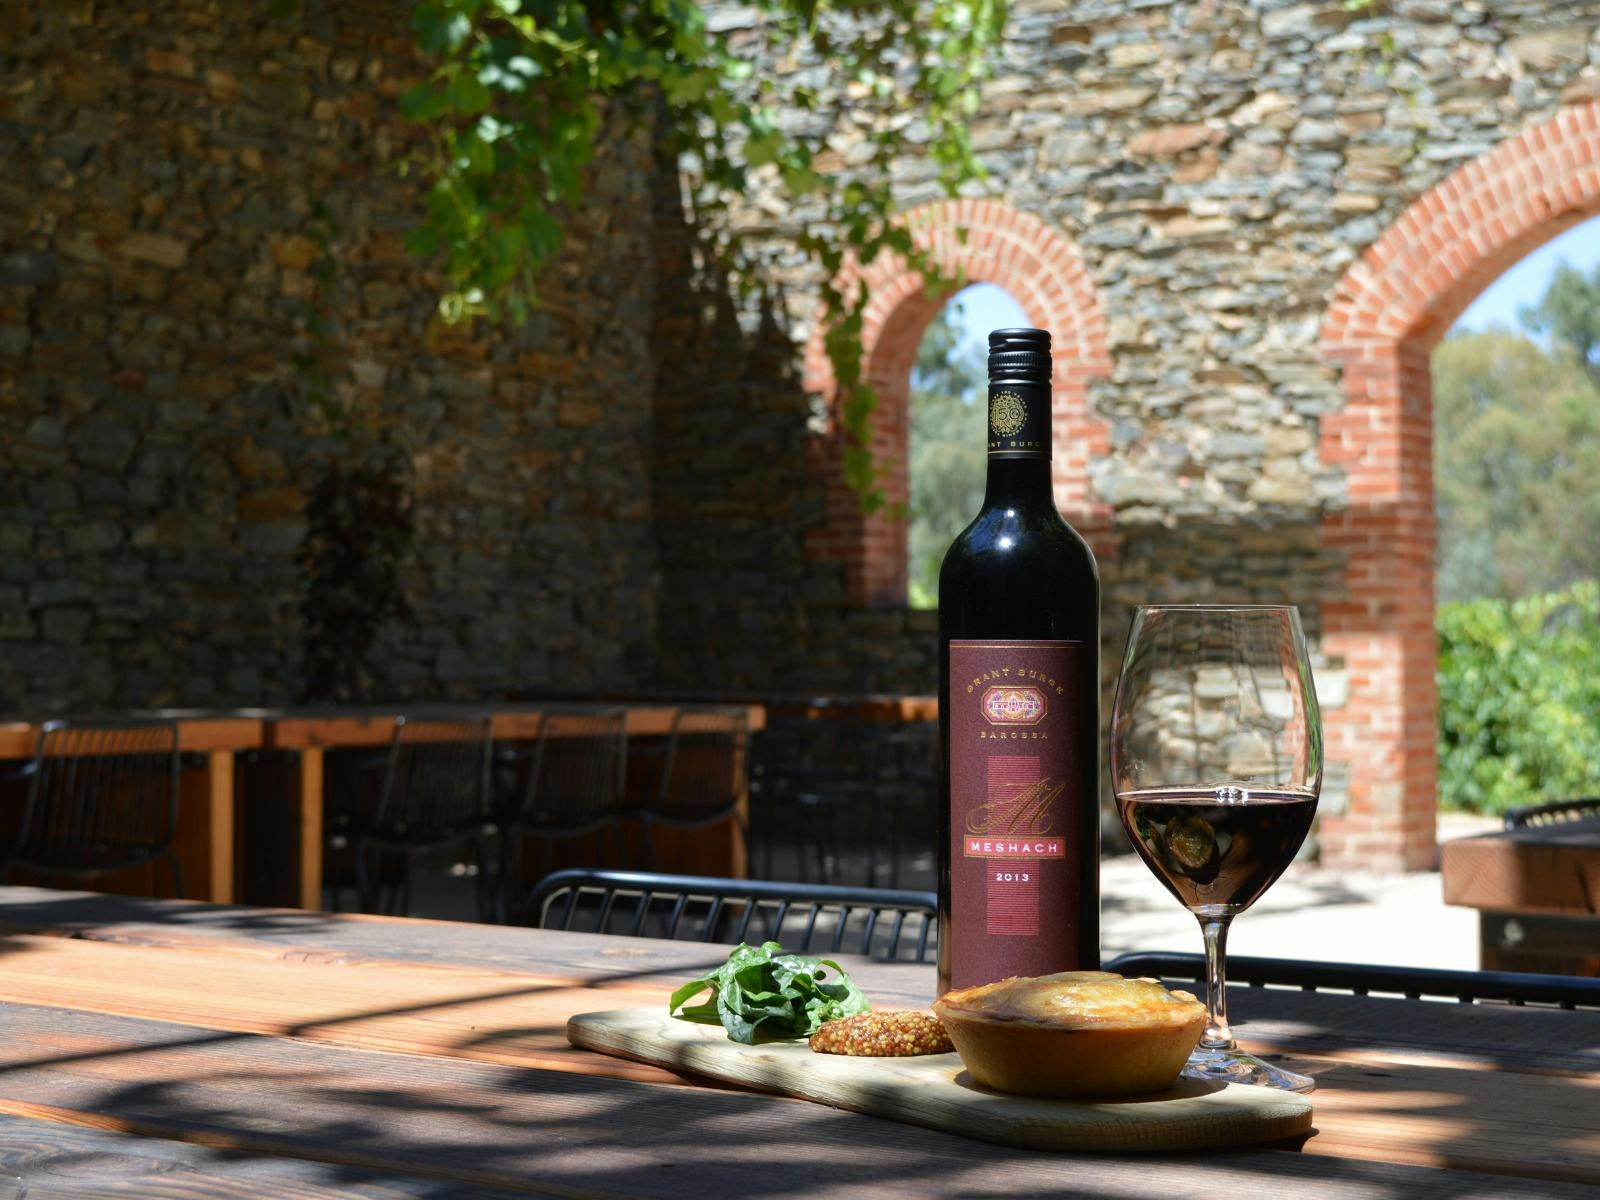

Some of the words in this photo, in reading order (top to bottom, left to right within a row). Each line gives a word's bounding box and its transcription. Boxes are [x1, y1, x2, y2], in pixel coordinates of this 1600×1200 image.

[966, 668, 1010, 693] GRANT
[980, 731, 1048, 739] BAROSSA
[971, 842, 1057, 853] MESHACH
[996, 873, 1030, 882] 2013
